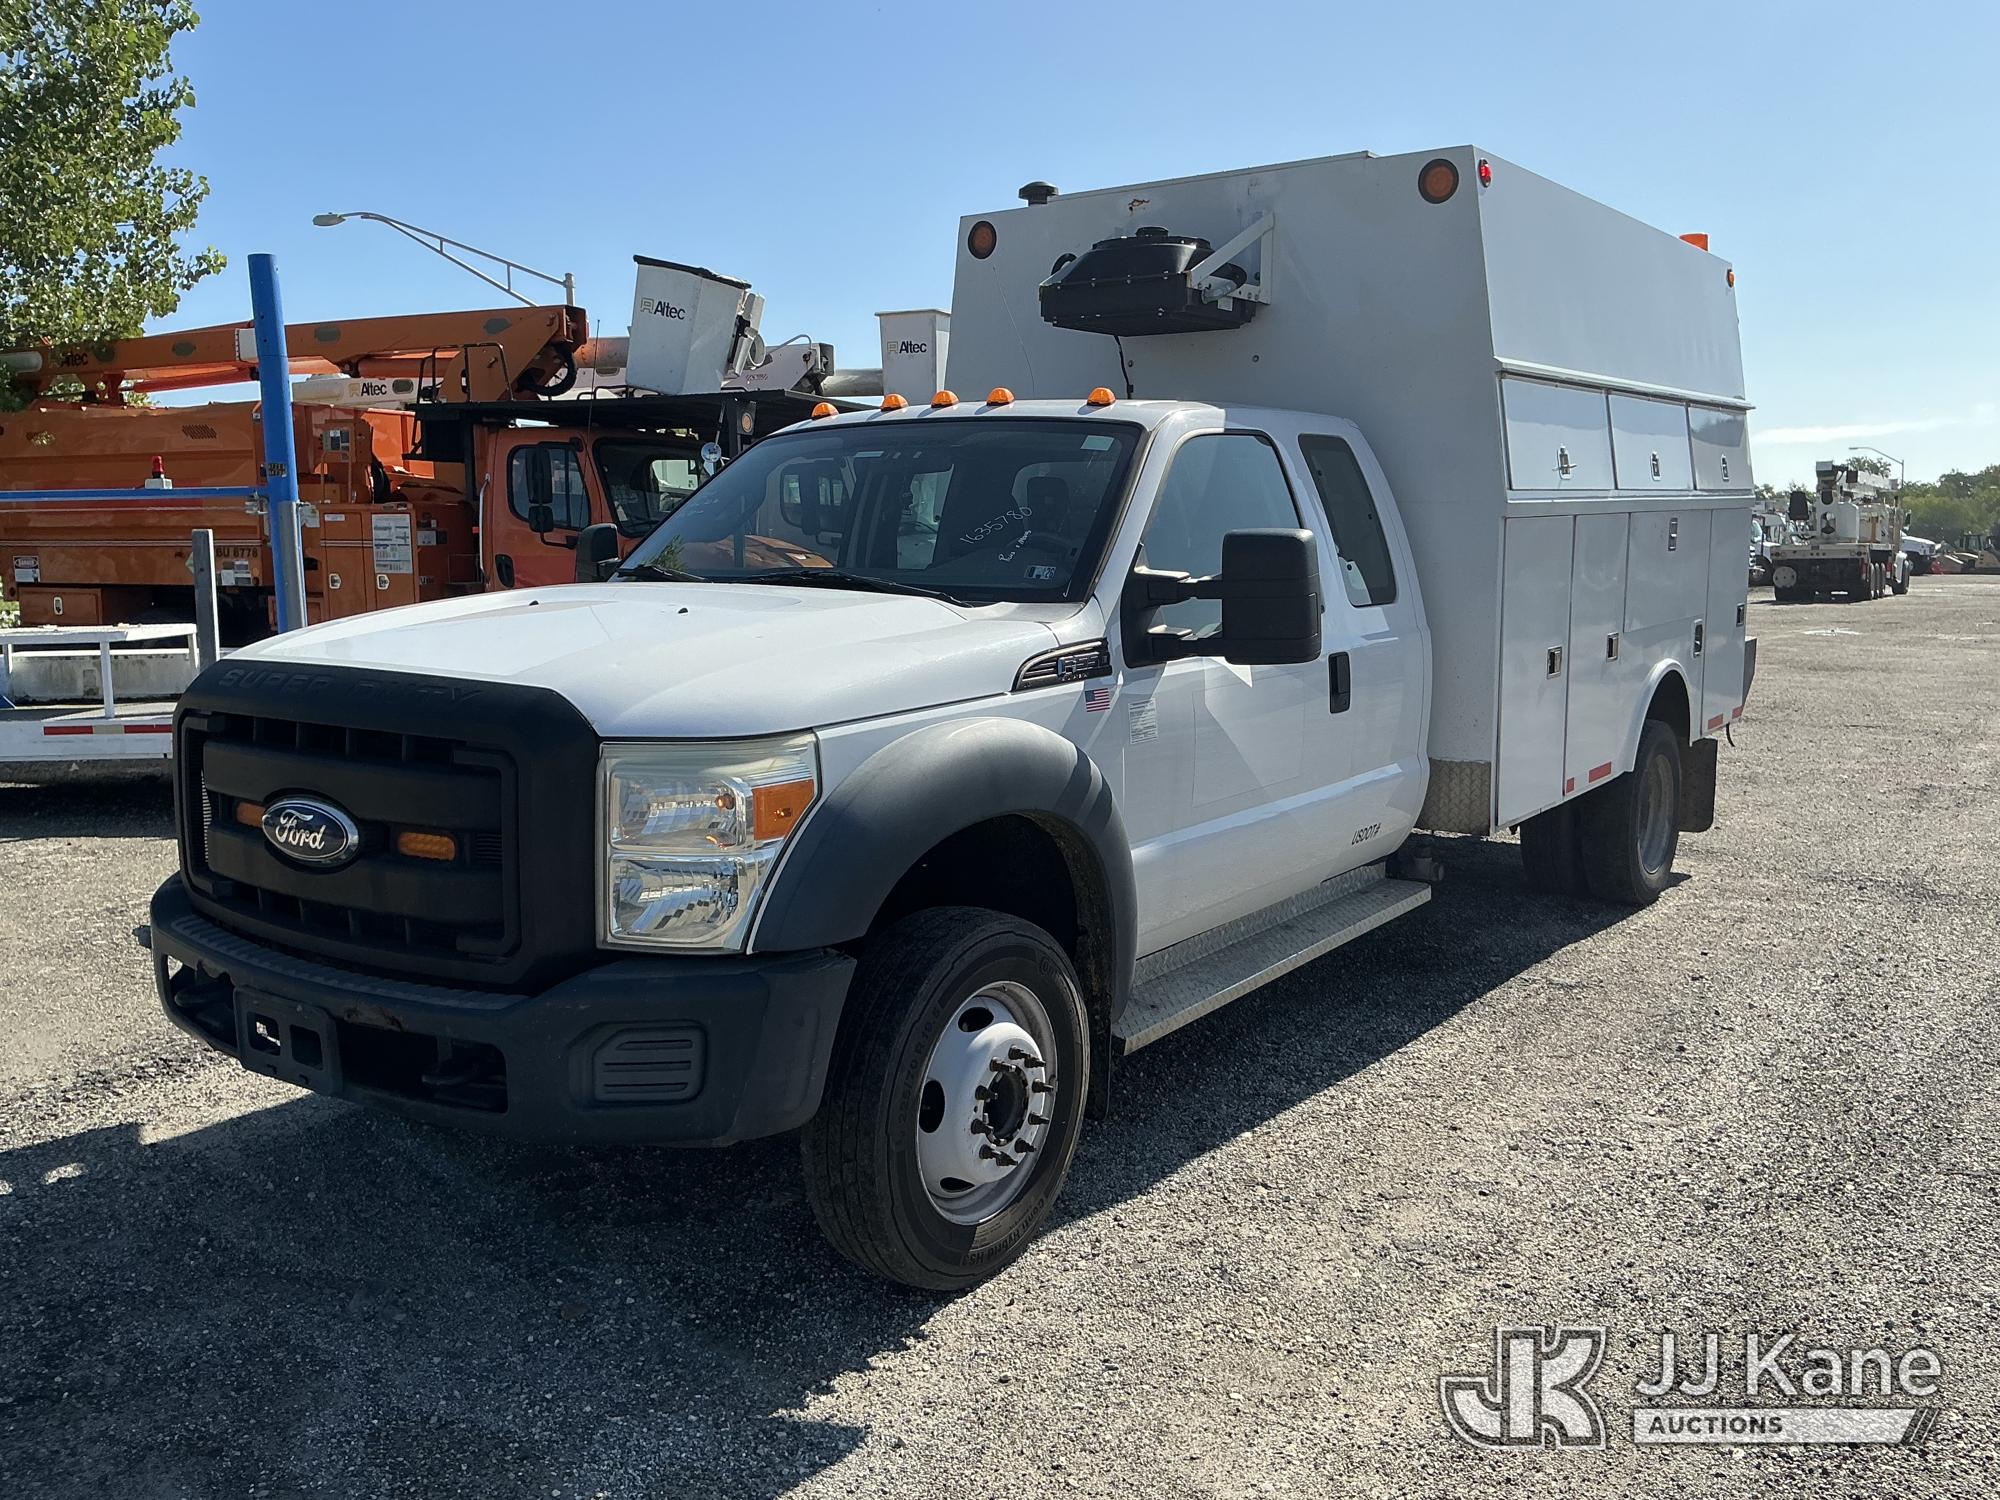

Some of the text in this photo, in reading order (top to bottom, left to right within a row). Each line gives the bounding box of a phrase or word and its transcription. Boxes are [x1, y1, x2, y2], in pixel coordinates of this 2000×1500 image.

[653, 300, 686, 320] Altec
[899, 340, 928, 354] Altec
[360, 382, 388, 397] Altec
[960, 506, 1032, 544] 1635780
[218, 668, 336, 696] SUPER
[276, 809, 327, 850] Ford
[1351, 822, 1382, 846] USDOT#
